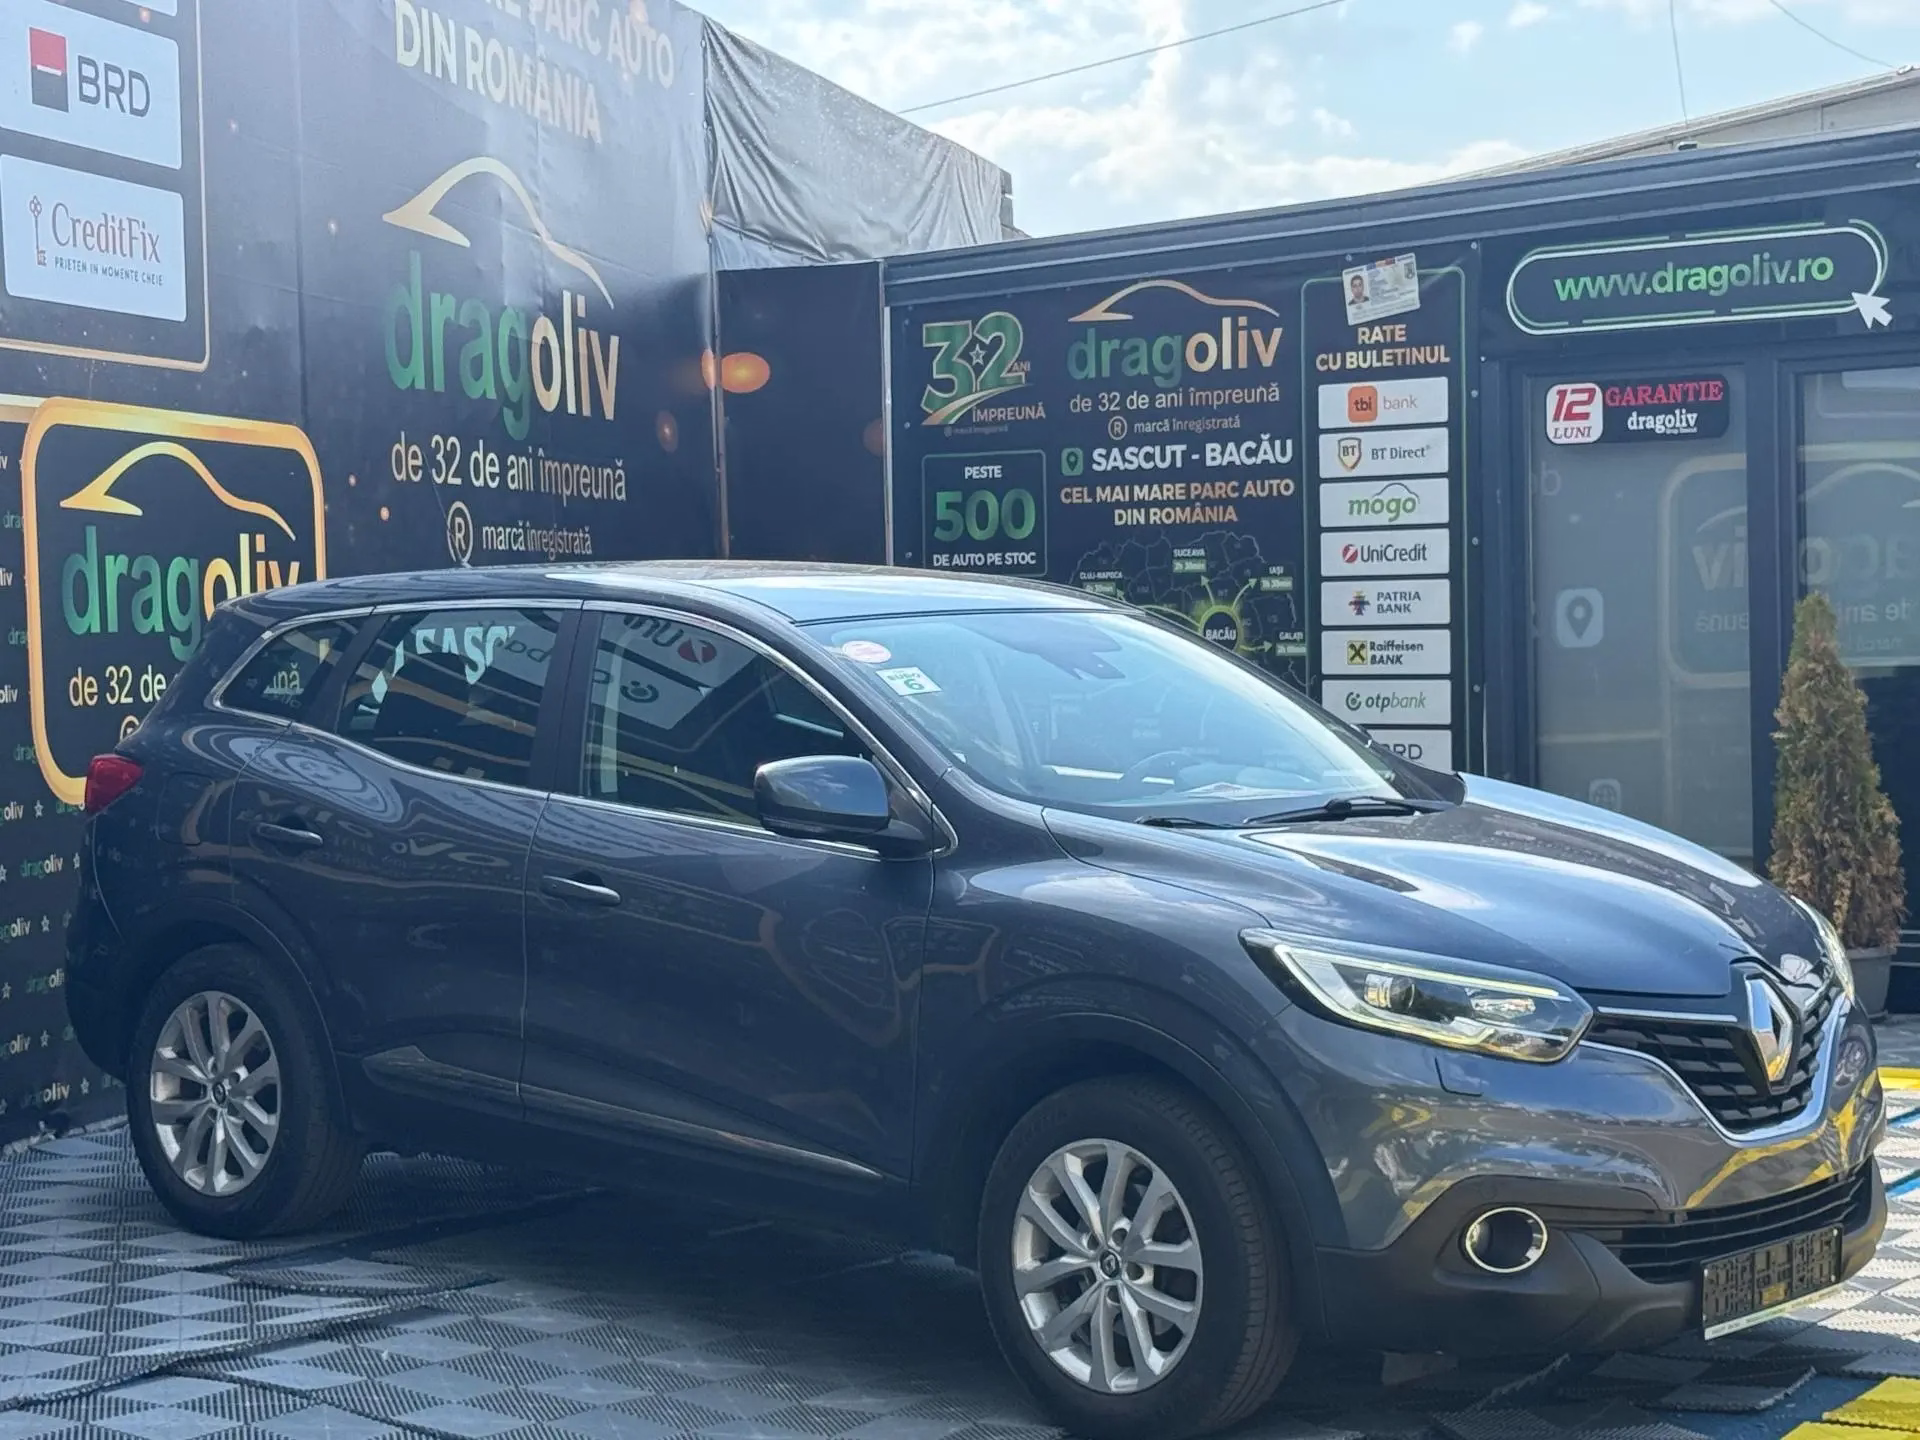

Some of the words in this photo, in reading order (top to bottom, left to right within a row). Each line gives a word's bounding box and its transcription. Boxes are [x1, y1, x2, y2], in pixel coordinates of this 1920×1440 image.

[606, 7, 675, 89] AUTO
[77, 54, 151, 118] BRD
[396, 0, 458, 86] DIN
[464, 26, 602, 145] ROMÂNIA
[51, 202, 161, 264] CreditFix
[54, 255, 88, 273] PRIETEN
[90, 263, 99, 275] IN
[101, 265, 139, 283] MOMENTE
[141, 272, 164, 286] CHEIE
[1553, 251, 1835, 303] www.dragoliv.ro
[384, 248, 620, 441] dragoliv
[1357, 323, 1407, 346] RATE
[919, 311, 1026, 415] 32
[1066, 315, 1284, 389] dragoliv
[1315, 352, 1342, 372] CU
[1345, 344, 1451, 370] BULETINUL
[1012, 361, 1031, 373] ANI
[1070, 395, 1092, 412] de
[1098, 391, 1121, 412] 32
[1126, 391, 1150, 411] de
[1155, 387, 1183, 408] ani
[1189, 381, 1280, 410] împreună
[1353, 396, 1373, 412] tbi
[1383, 394, 1418, 411] bank
[1552, 387, 1597, 423] 12
[1604, 380, 1724, 407] GARANTIE
[972, 401, 1046, 423] ÎMPREUNĂ
[1134, 418, 1170, 434] marcă
[1172, 414, 1241, 434] înregistrată
[1627, 407, 1698, 435] dragoliv
[1553, 425, 1593, 440] LUNI
[1091, 443, 1187, 472] SASCUT
[1205, 433, 1293, 468] BACĂU
[1341, 444, 1357, 457] BT
[1371, 447, 1388, 461] BT
[392, 430, 423, 483] de
[430, 433, 462, 486] 32
[469, 439, 500, 489] de
[507, 446, 533, 492] ani
[538, 449, 627, 507] împreună
[964, 465, 1003, 480] PESTE
[1060, 486, 1093, 505] CEL
[1096, 484, 1130, 503] MAI
[1133, 482, 1187, 502] MARE
[1190, 481, 1239, 500] PARC
[1243, 478, 1295, 498] AUTO
[933, 487, 1037, 542] 500
[1114, 508, 1146, 526] DIN
[1149, 502, 1239, 524] ROMÂNIA
[1347, 496, 1417, 523] mogo
[482, 519, 525, 553] marcă
[526, 522, 593, 560] înregistrată
[933, 553, 951, 567] DE
[952, 552, 985, 566] AUTO
[987, 552, 1002, 566] PE
[1002, 551, 1037, 565] STOC
[1360, 543, 1428, 564] UniCredit
[1377, 591, 1422, 602] PATRIA
[1377, 603, 1412, 614] BANK
[1370, 640, 1424, 652] Raiffeisen
[1370, 654, 1404, 666] BANK
[69, 667, 99, 707] de
[104, 664, 134, 705] 32
[139, 664, 167, 703] de
[1365, 691, 1427, 713] otpbank
